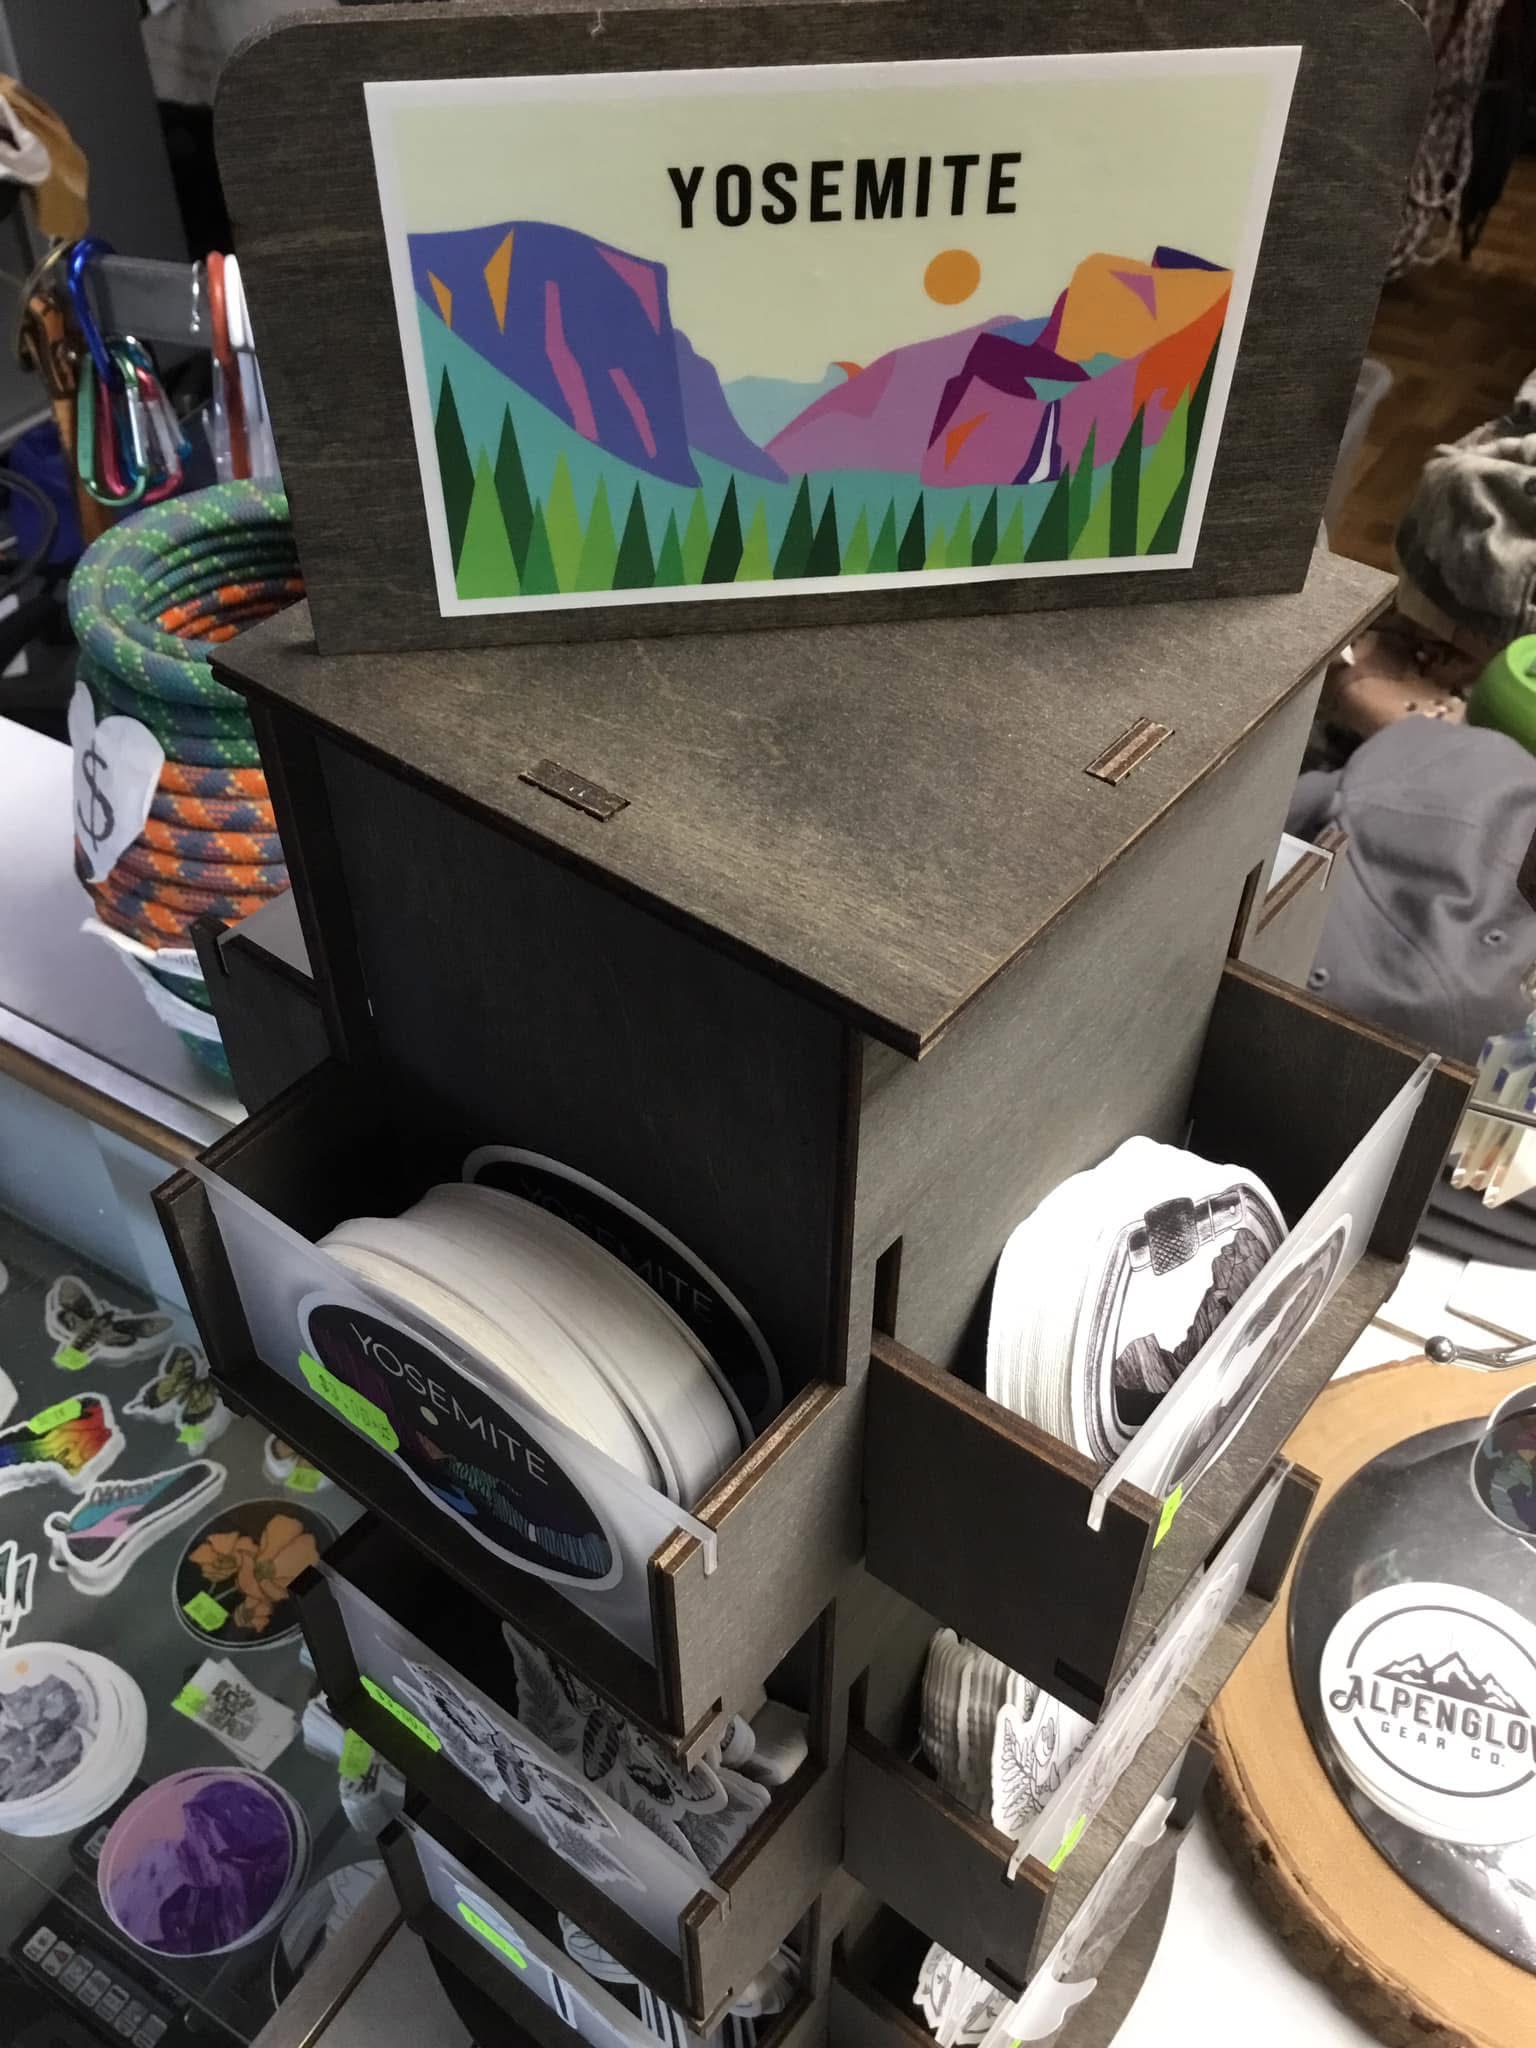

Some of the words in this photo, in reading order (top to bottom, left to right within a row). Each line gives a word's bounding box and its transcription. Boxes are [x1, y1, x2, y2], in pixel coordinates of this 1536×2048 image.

[667, 152, 1022, 228] YOSEMITE
[350, 1322, 548, 1486] YOSEMITE
[1329, 1674, 1536, 1764] ALPENGLO
[1380, 1721, 1447, 1750] GEAR
[1471, 1746, 1506, 1767] CO.
